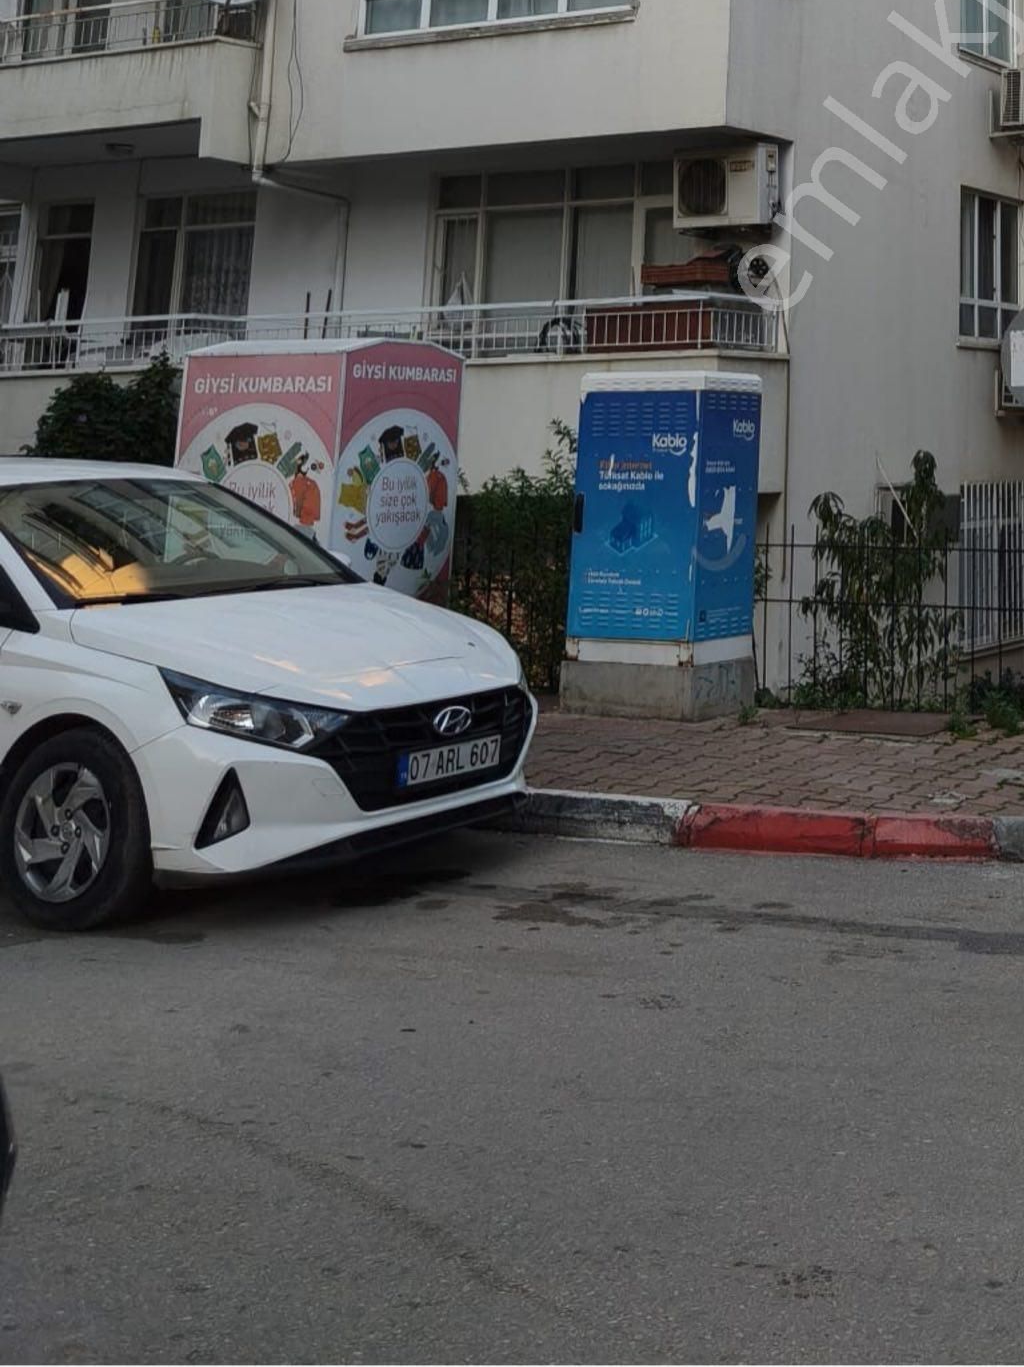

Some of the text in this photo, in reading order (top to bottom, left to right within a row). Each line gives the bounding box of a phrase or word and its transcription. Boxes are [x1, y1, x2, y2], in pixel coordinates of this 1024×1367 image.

[353, 360, 457, 383] GİYSİ KUMBARASI
[194, 373, 333, 394] GİYSİ KUMBARASI
[733, 418, 755, 433] Kablo
[652, 432, 687, 447] Kablo
[248, 482, 276, 500] iyilik
[383, 477, 416, 493] Bu iyilik
[380, 493, 417, 510] size çok
[376, 510, 420, 527] yakışacak
[410, 754, 431, 780] 07
[436, 745, 464, 775] ARL
[470, 738, 499, 766] 607
